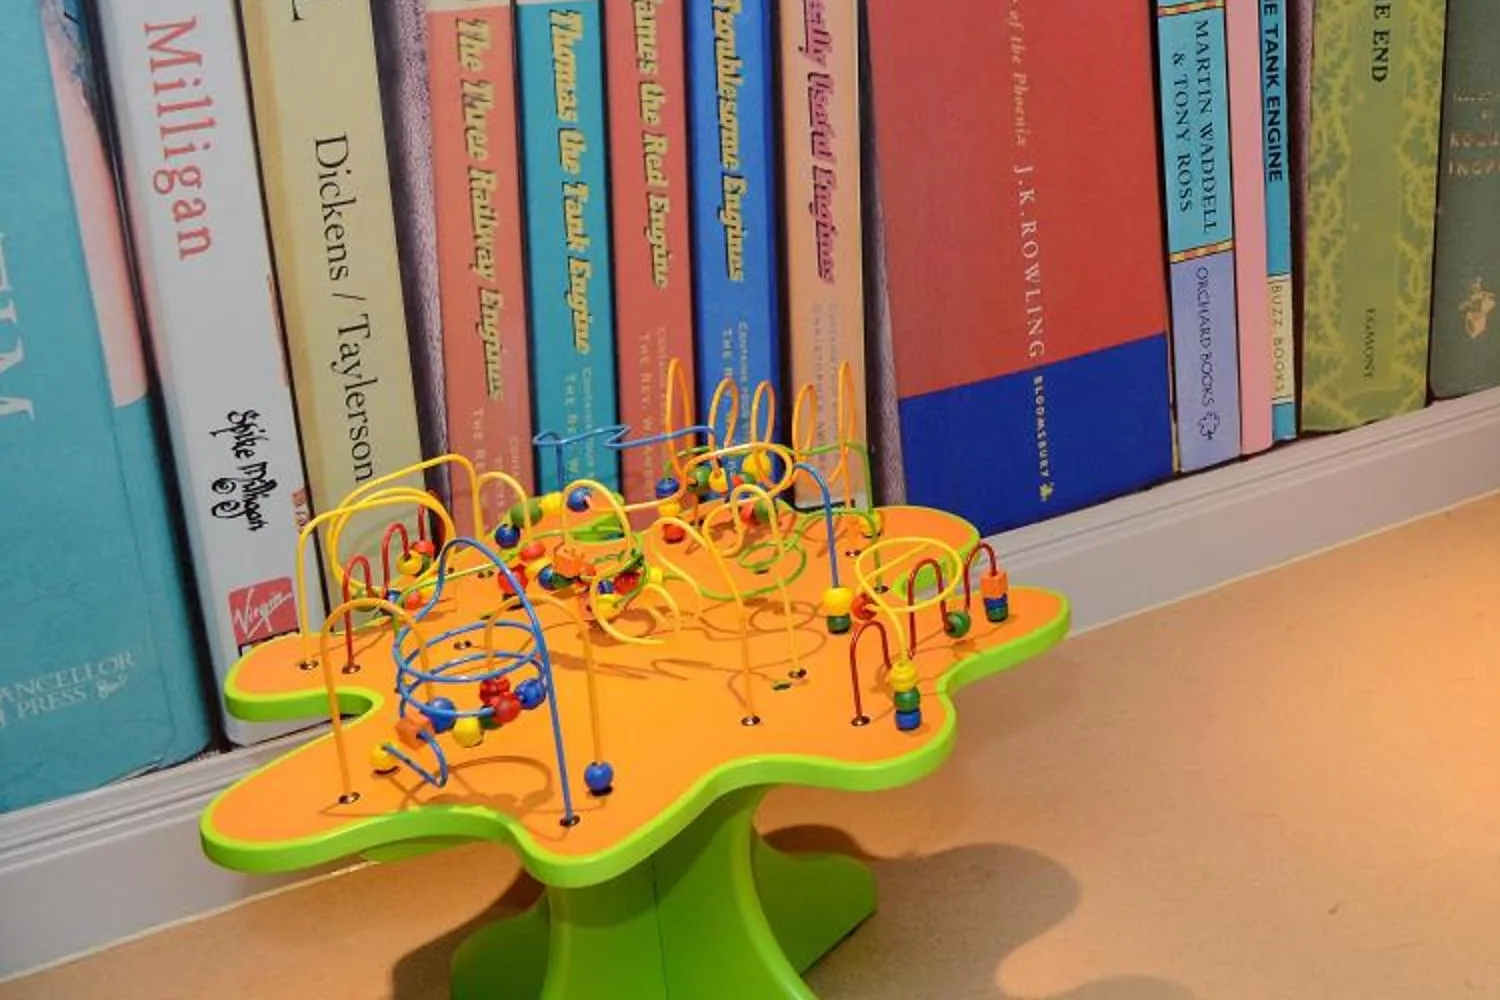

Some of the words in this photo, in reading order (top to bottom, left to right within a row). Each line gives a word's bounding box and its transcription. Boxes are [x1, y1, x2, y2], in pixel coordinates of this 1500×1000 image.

[455, 16, 493, 72] The
[549, 9, 584, 124] Thomas
[1193, 17, 1213, 114] MARTIN
[1264, 23, 1280, 93] TANK
[1371, 28, 1390, 84] END
[142, 15, 213, 260] Milligan
[462, 78, 498, 163] Three
[639, 80, 666, 128] the
[807, 72, 838, 163] Useful
[1172, 75, 1191, 144] TONY
[1265, 95, 1283, 182] ENGINE
[559, 127, 586, 175] the
[641, 132, 670, 190] Red
[1177, 153, 1194, 213] ROSS
[1199, 123, 1218, 235] WADDELL
[314, 134, 357, 282] Dickens
[468, 166, 503, 283] Railway
[562, 180, 591, 254] Tank
[644, 192, 672, 290] Engine
[717, 172, 749, 284] Engines
[808, 166, 839, 286] Engines
[476, 286, 504, 398] Engines
[564, 256, 593, 356] Engine
[1194, 265, 1214, 349] ORCHARD
[1271, 284, 1283, 332] BUZZ
[1362, 307, 1377, 380] EGMONT
[329, 313, 378, 484] Taylerson
[1199, 350, 1216, 408] BOOKS
[1273, 336, 1286, 394] BOOKS
[209, 409, 270, 459] Spike
[1033, 374, 1050, 478] BLOOMSBURY
[232, 587, 293, 639] Virgin
[0, 651, 138, 704] ANCELLOR
[18, 683, 88, 720] PRESS
